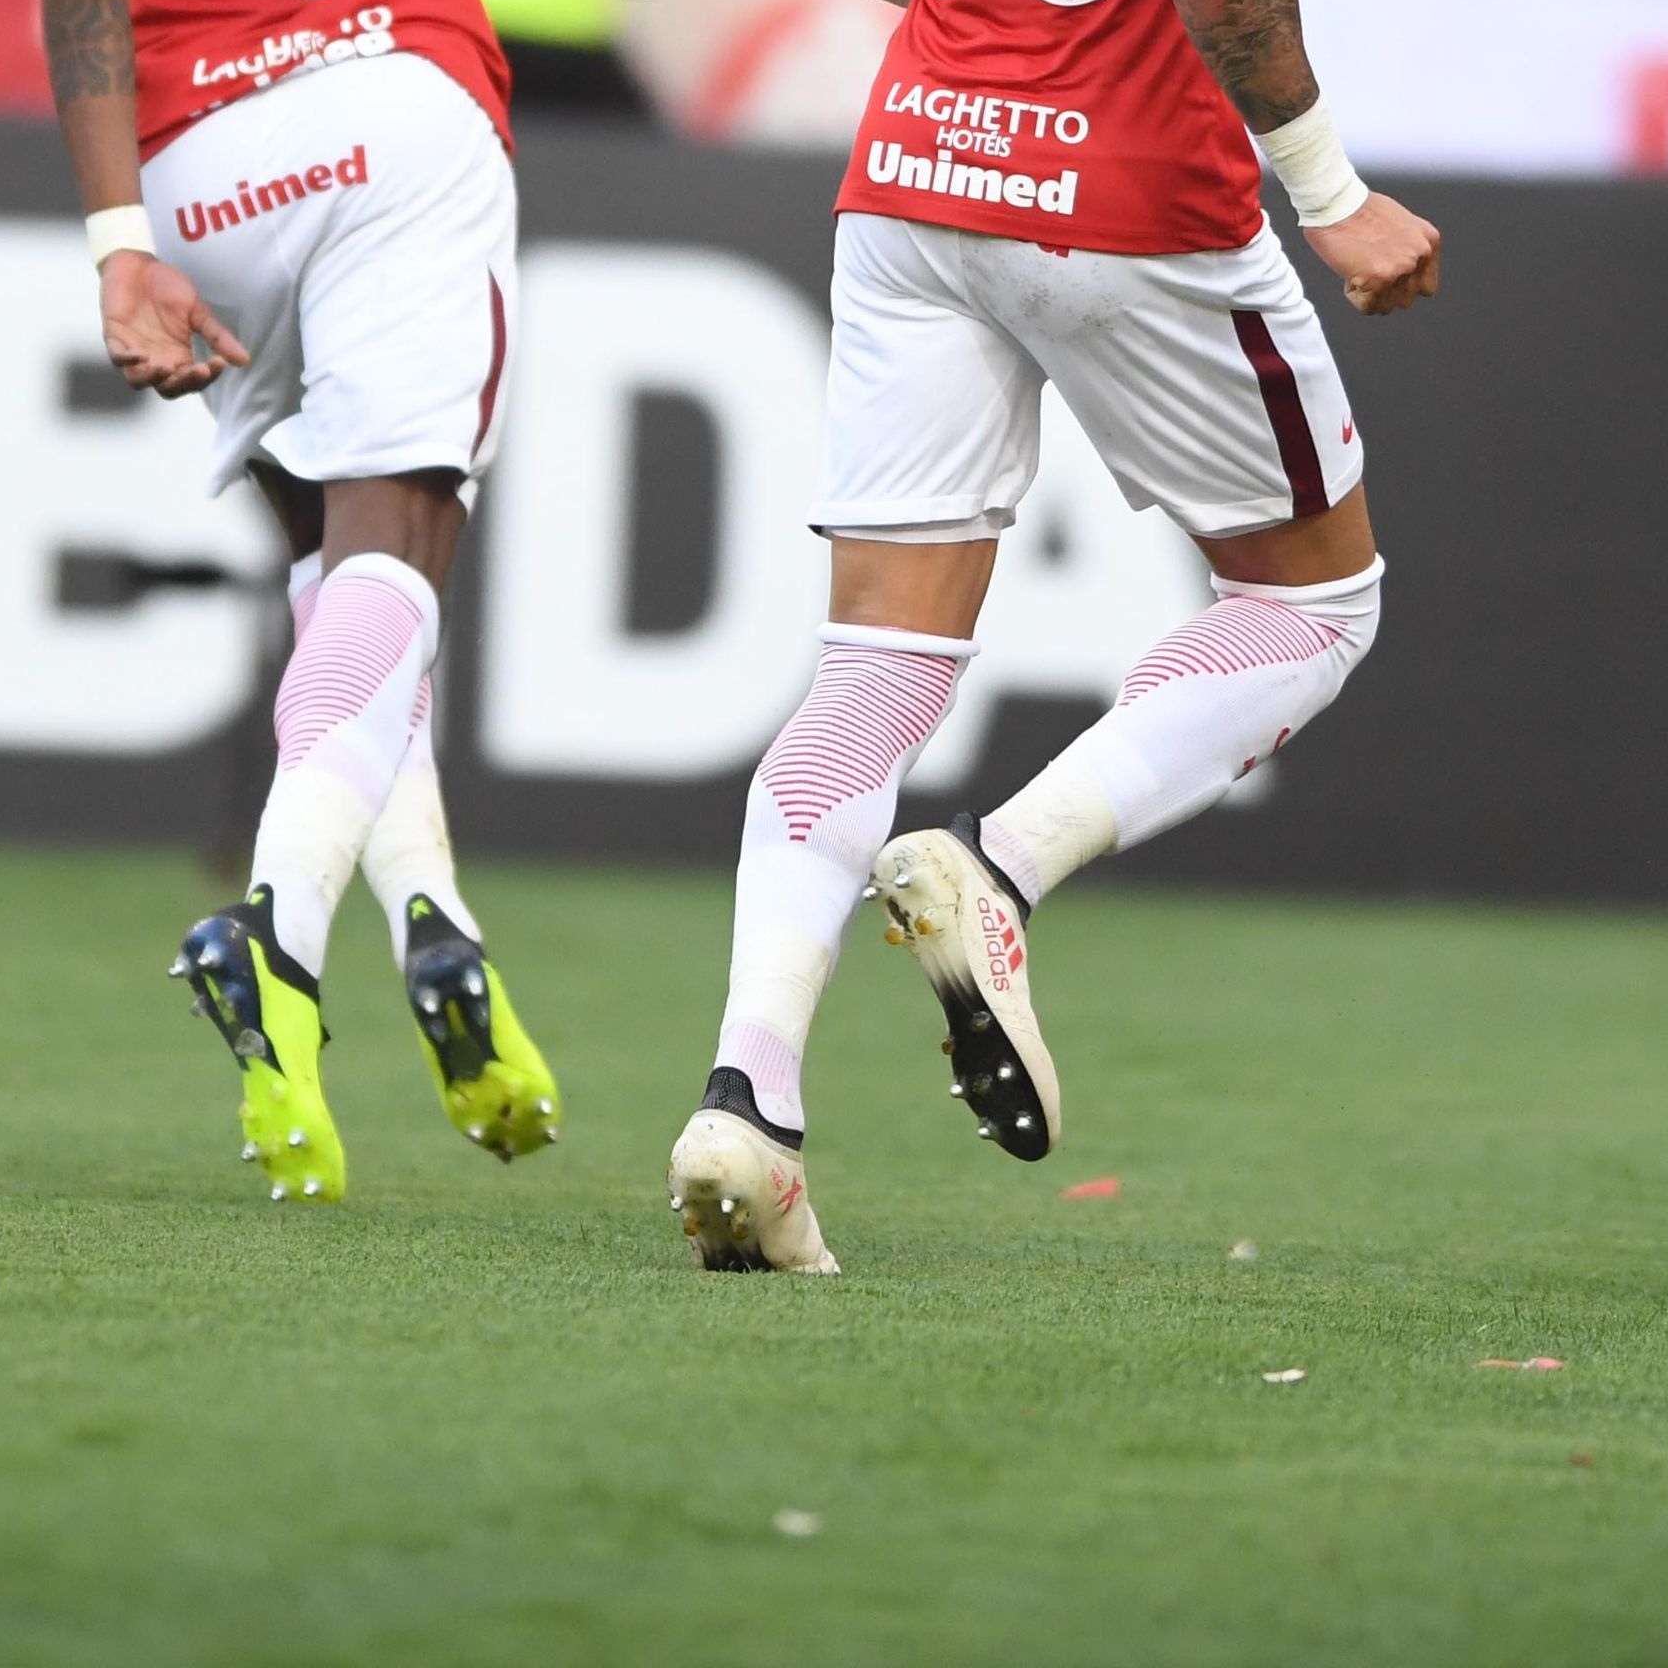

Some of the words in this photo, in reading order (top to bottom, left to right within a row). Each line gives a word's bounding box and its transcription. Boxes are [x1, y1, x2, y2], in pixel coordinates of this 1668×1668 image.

[884, 83, 1089, 144] LAGHETTO
[936, 126, 1011, 158] HOTÉIS
[175, 145, 369, 243] Unimed
[867, 140, 1078, 215] Unimed
[976, 897, 1011, 992] adidas
